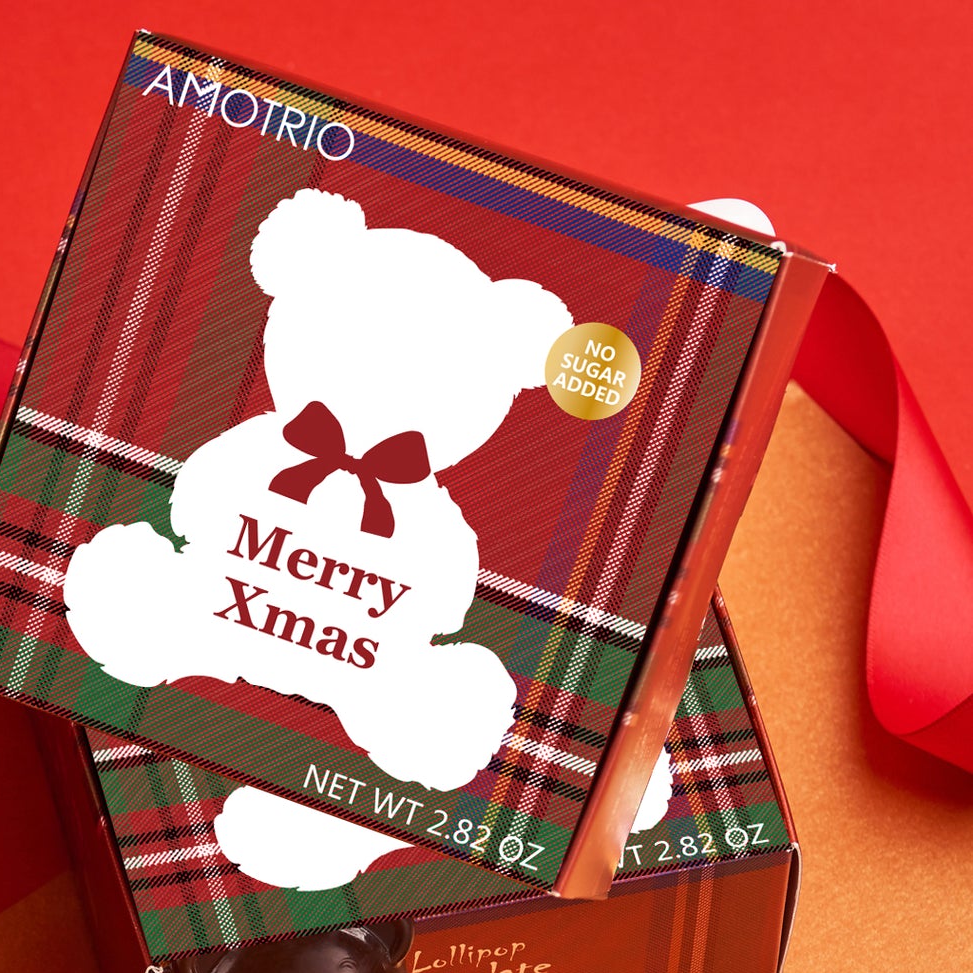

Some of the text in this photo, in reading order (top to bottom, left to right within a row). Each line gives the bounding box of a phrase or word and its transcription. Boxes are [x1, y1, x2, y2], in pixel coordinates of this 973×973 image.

[142, 64, 355, 161] AMOTRIO
[560, 353, 626, 388] SUGAR
[584, 339, 616, 362] NO
[552, 372, 621, 405] ADDED
[226, 513, 412, 618] Merry
[213, 576, 379, 669] Xmas
[303, 763, 546, 871] NET WT 2.82 OZ
[618, 823, 770, 868] T 2.82 OZ
[411, 942, 526, 973] Lollipop
